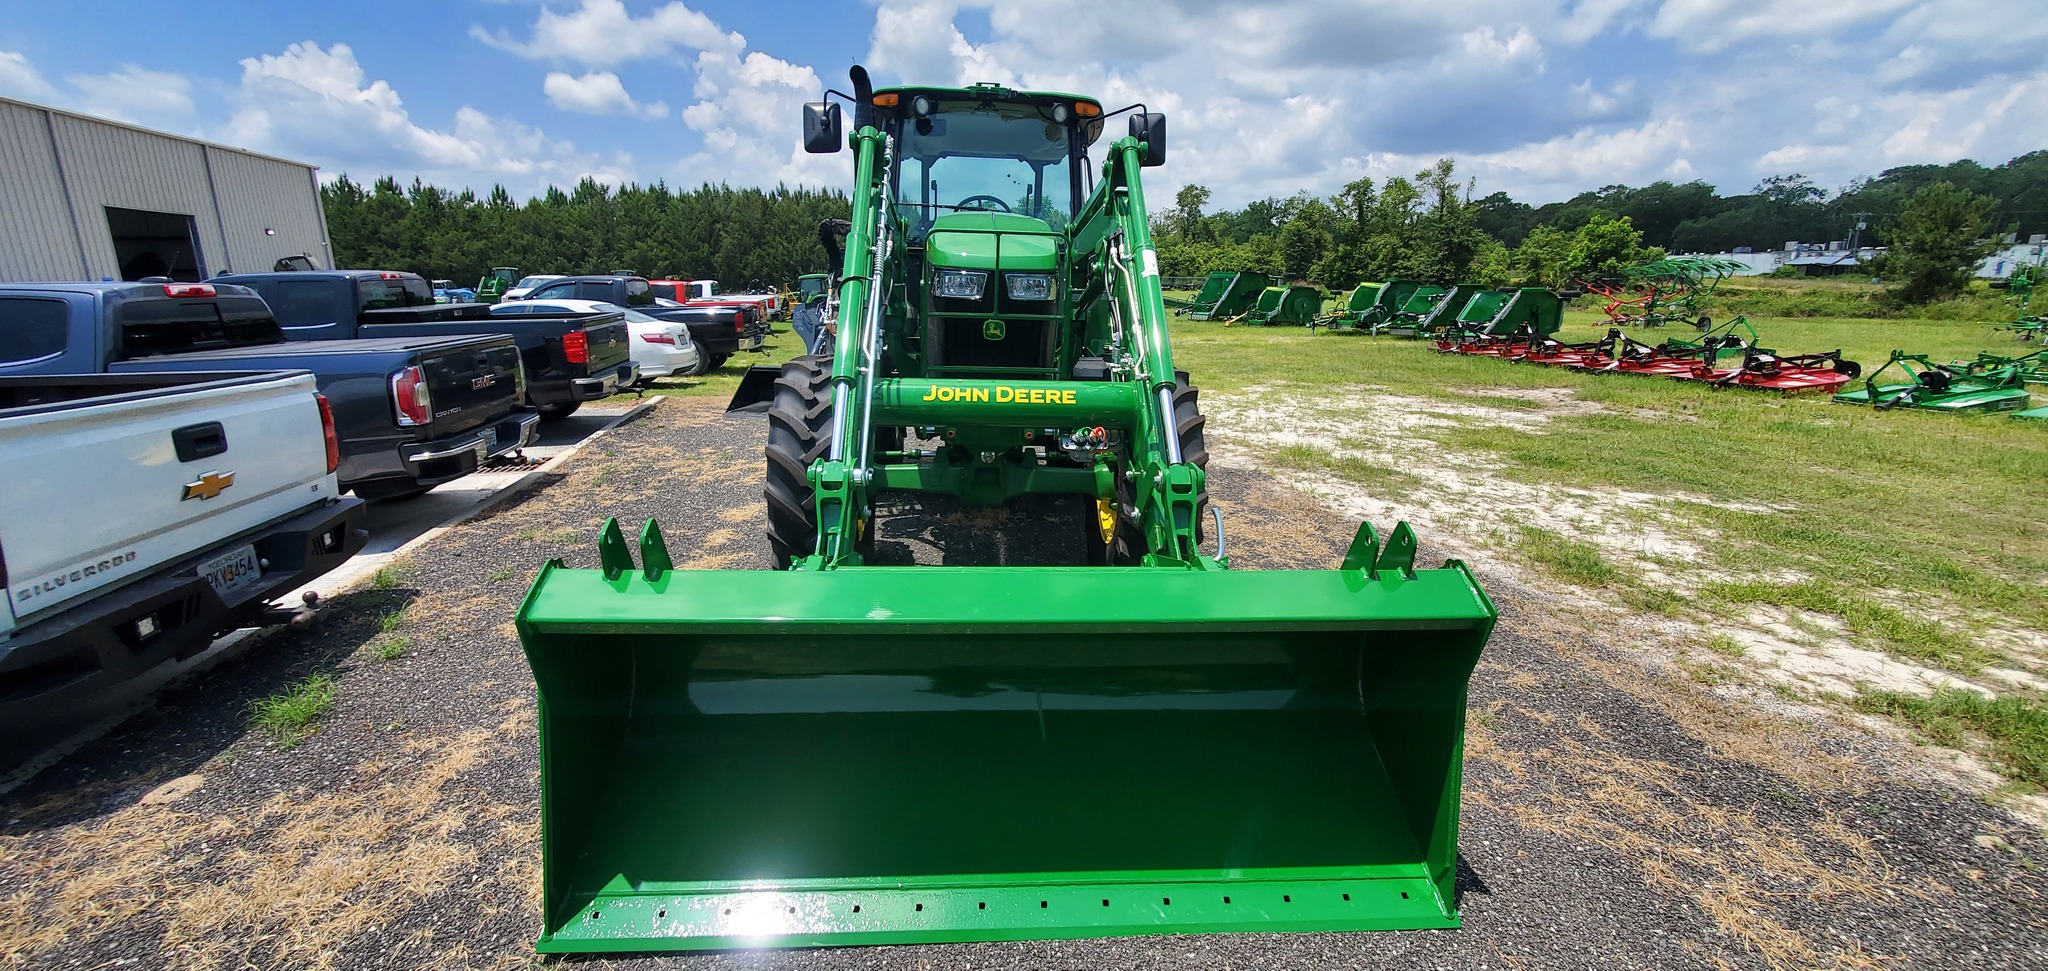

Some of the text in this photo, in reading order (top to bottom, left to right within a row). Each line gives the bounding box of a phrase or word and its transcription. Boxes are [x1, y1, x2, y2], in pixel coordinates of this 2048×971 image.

[472, 374, 495, 390] GMC
[923, 385, 1077, 404] JOHN DEERE
[17, 551, 137, 602] SILVERADO
